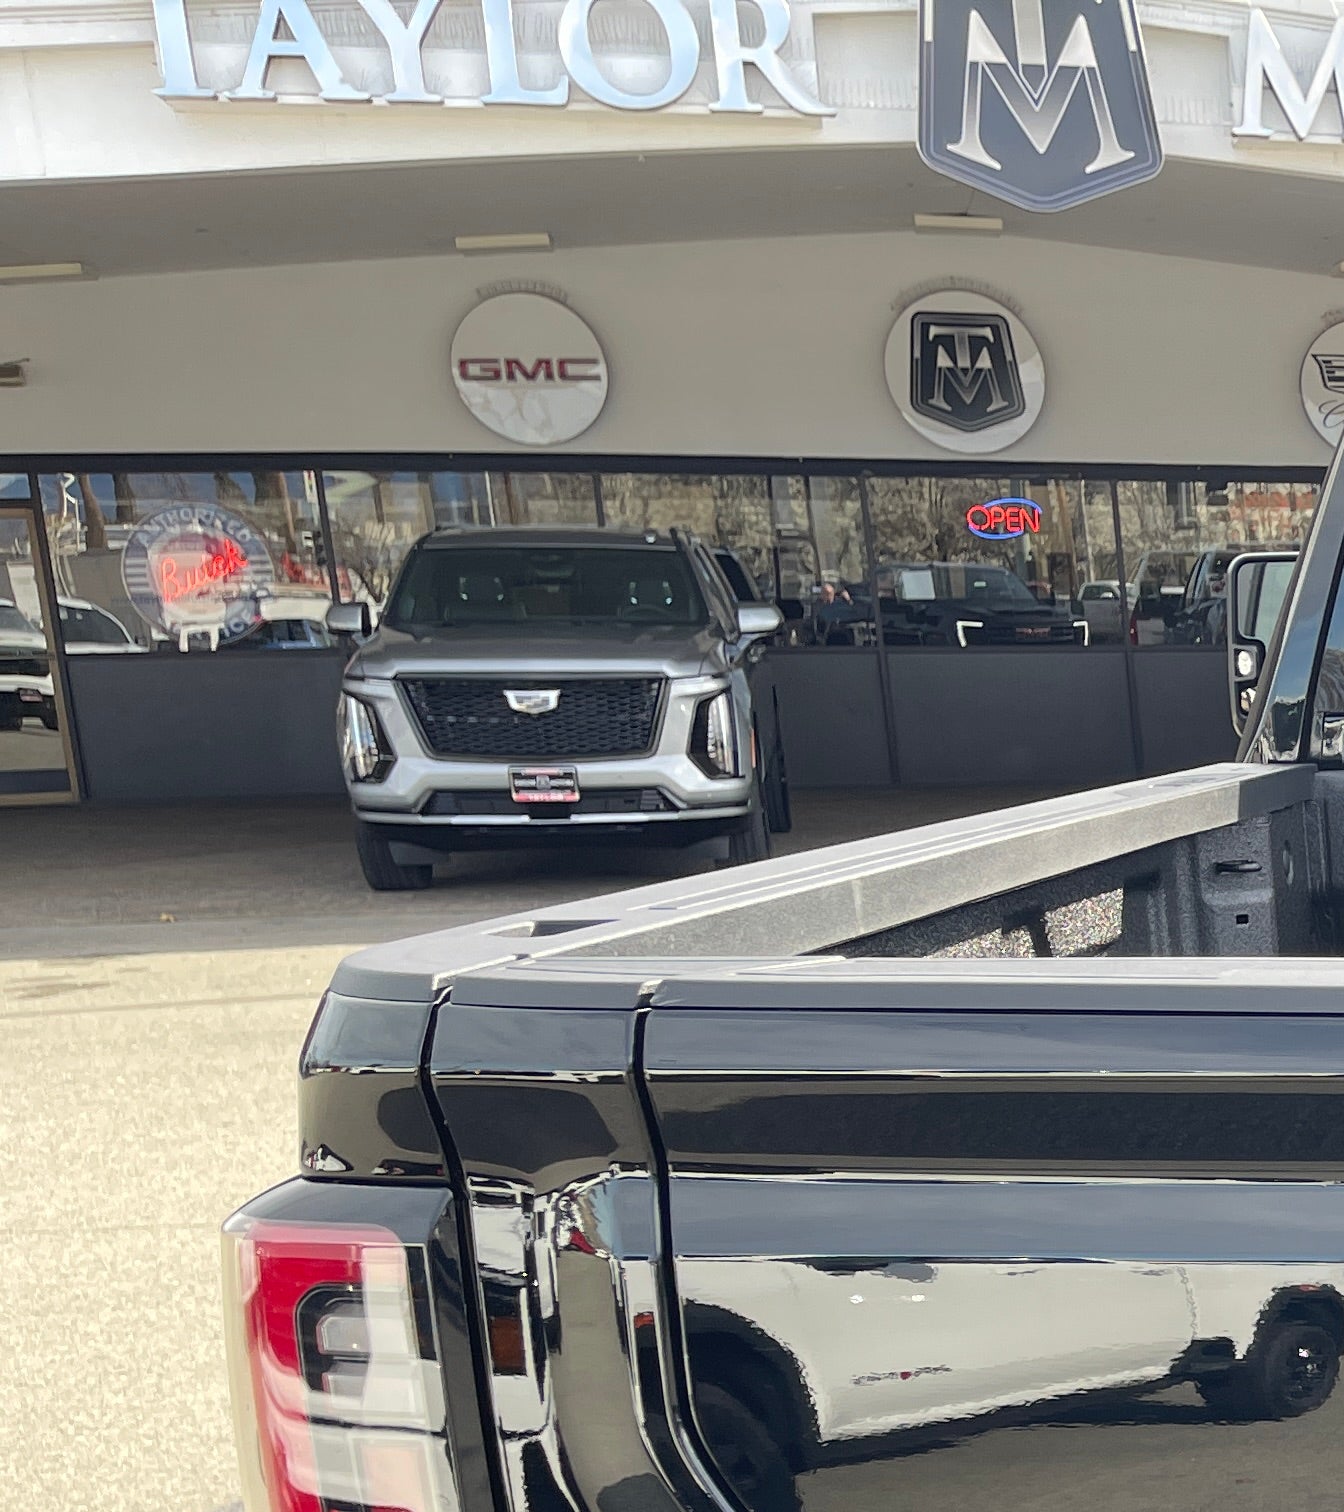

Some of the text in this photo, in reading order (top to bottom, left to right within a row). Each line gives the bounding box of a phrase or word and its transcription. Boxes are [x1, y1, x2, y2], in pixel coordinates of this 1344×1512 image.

[458, 357, 601, 382] GMC
[966, 504, 1041, 533] OPEN
[160, 537, 249, 604] Buick
